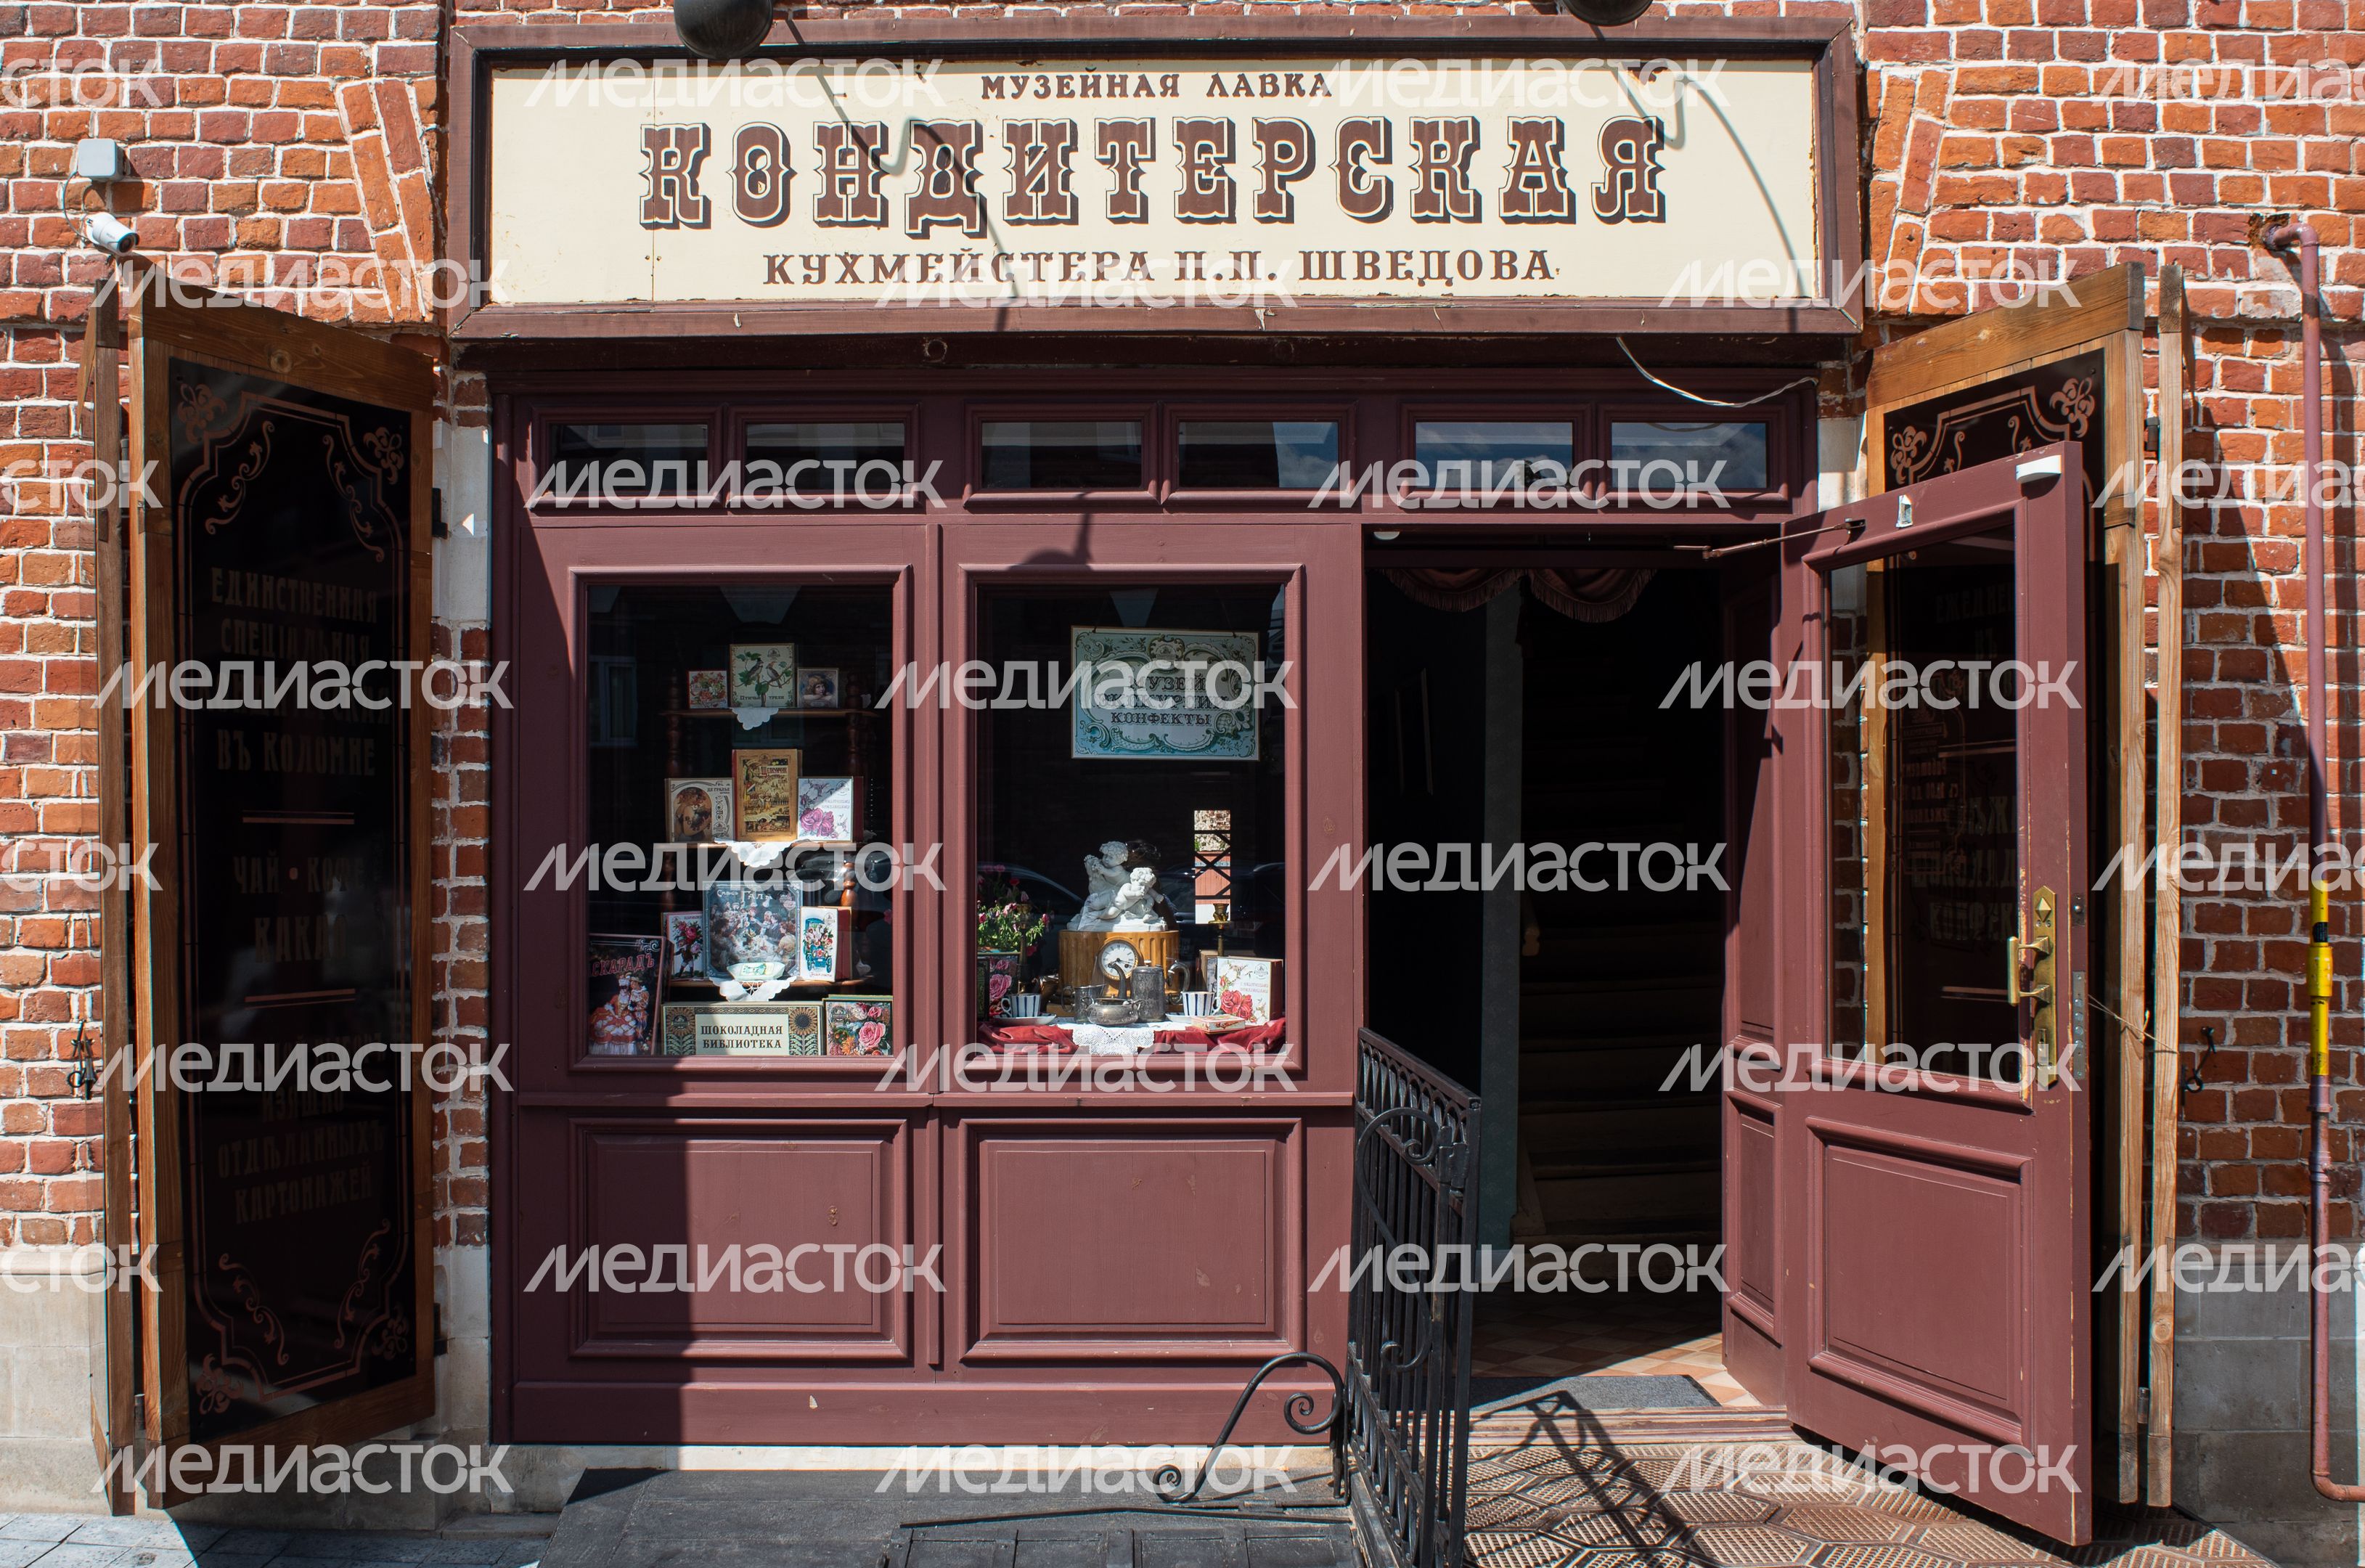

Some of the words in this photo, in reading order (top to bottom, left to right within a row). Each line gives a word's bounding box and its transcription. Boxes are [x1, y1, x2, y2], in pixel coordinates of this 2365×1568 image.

[982, 66, 1180, 100] МУЗЕЙНАЯ
[639, 118, 1667, 240] КОНДИТЕРСКАЯ
[763, 248, 1153, 285] КУХМЕЙСТЕРА
[1300, 250, 1557, 287] ШВЕДОВА
[1111, 712, 1212, 725] КОНФЕКТЫ
[701, 1025, 783, 1037] ШОКОЛАДНАЯ
[703, 1040, 783, 1048] БИБЛИОТЕКА
